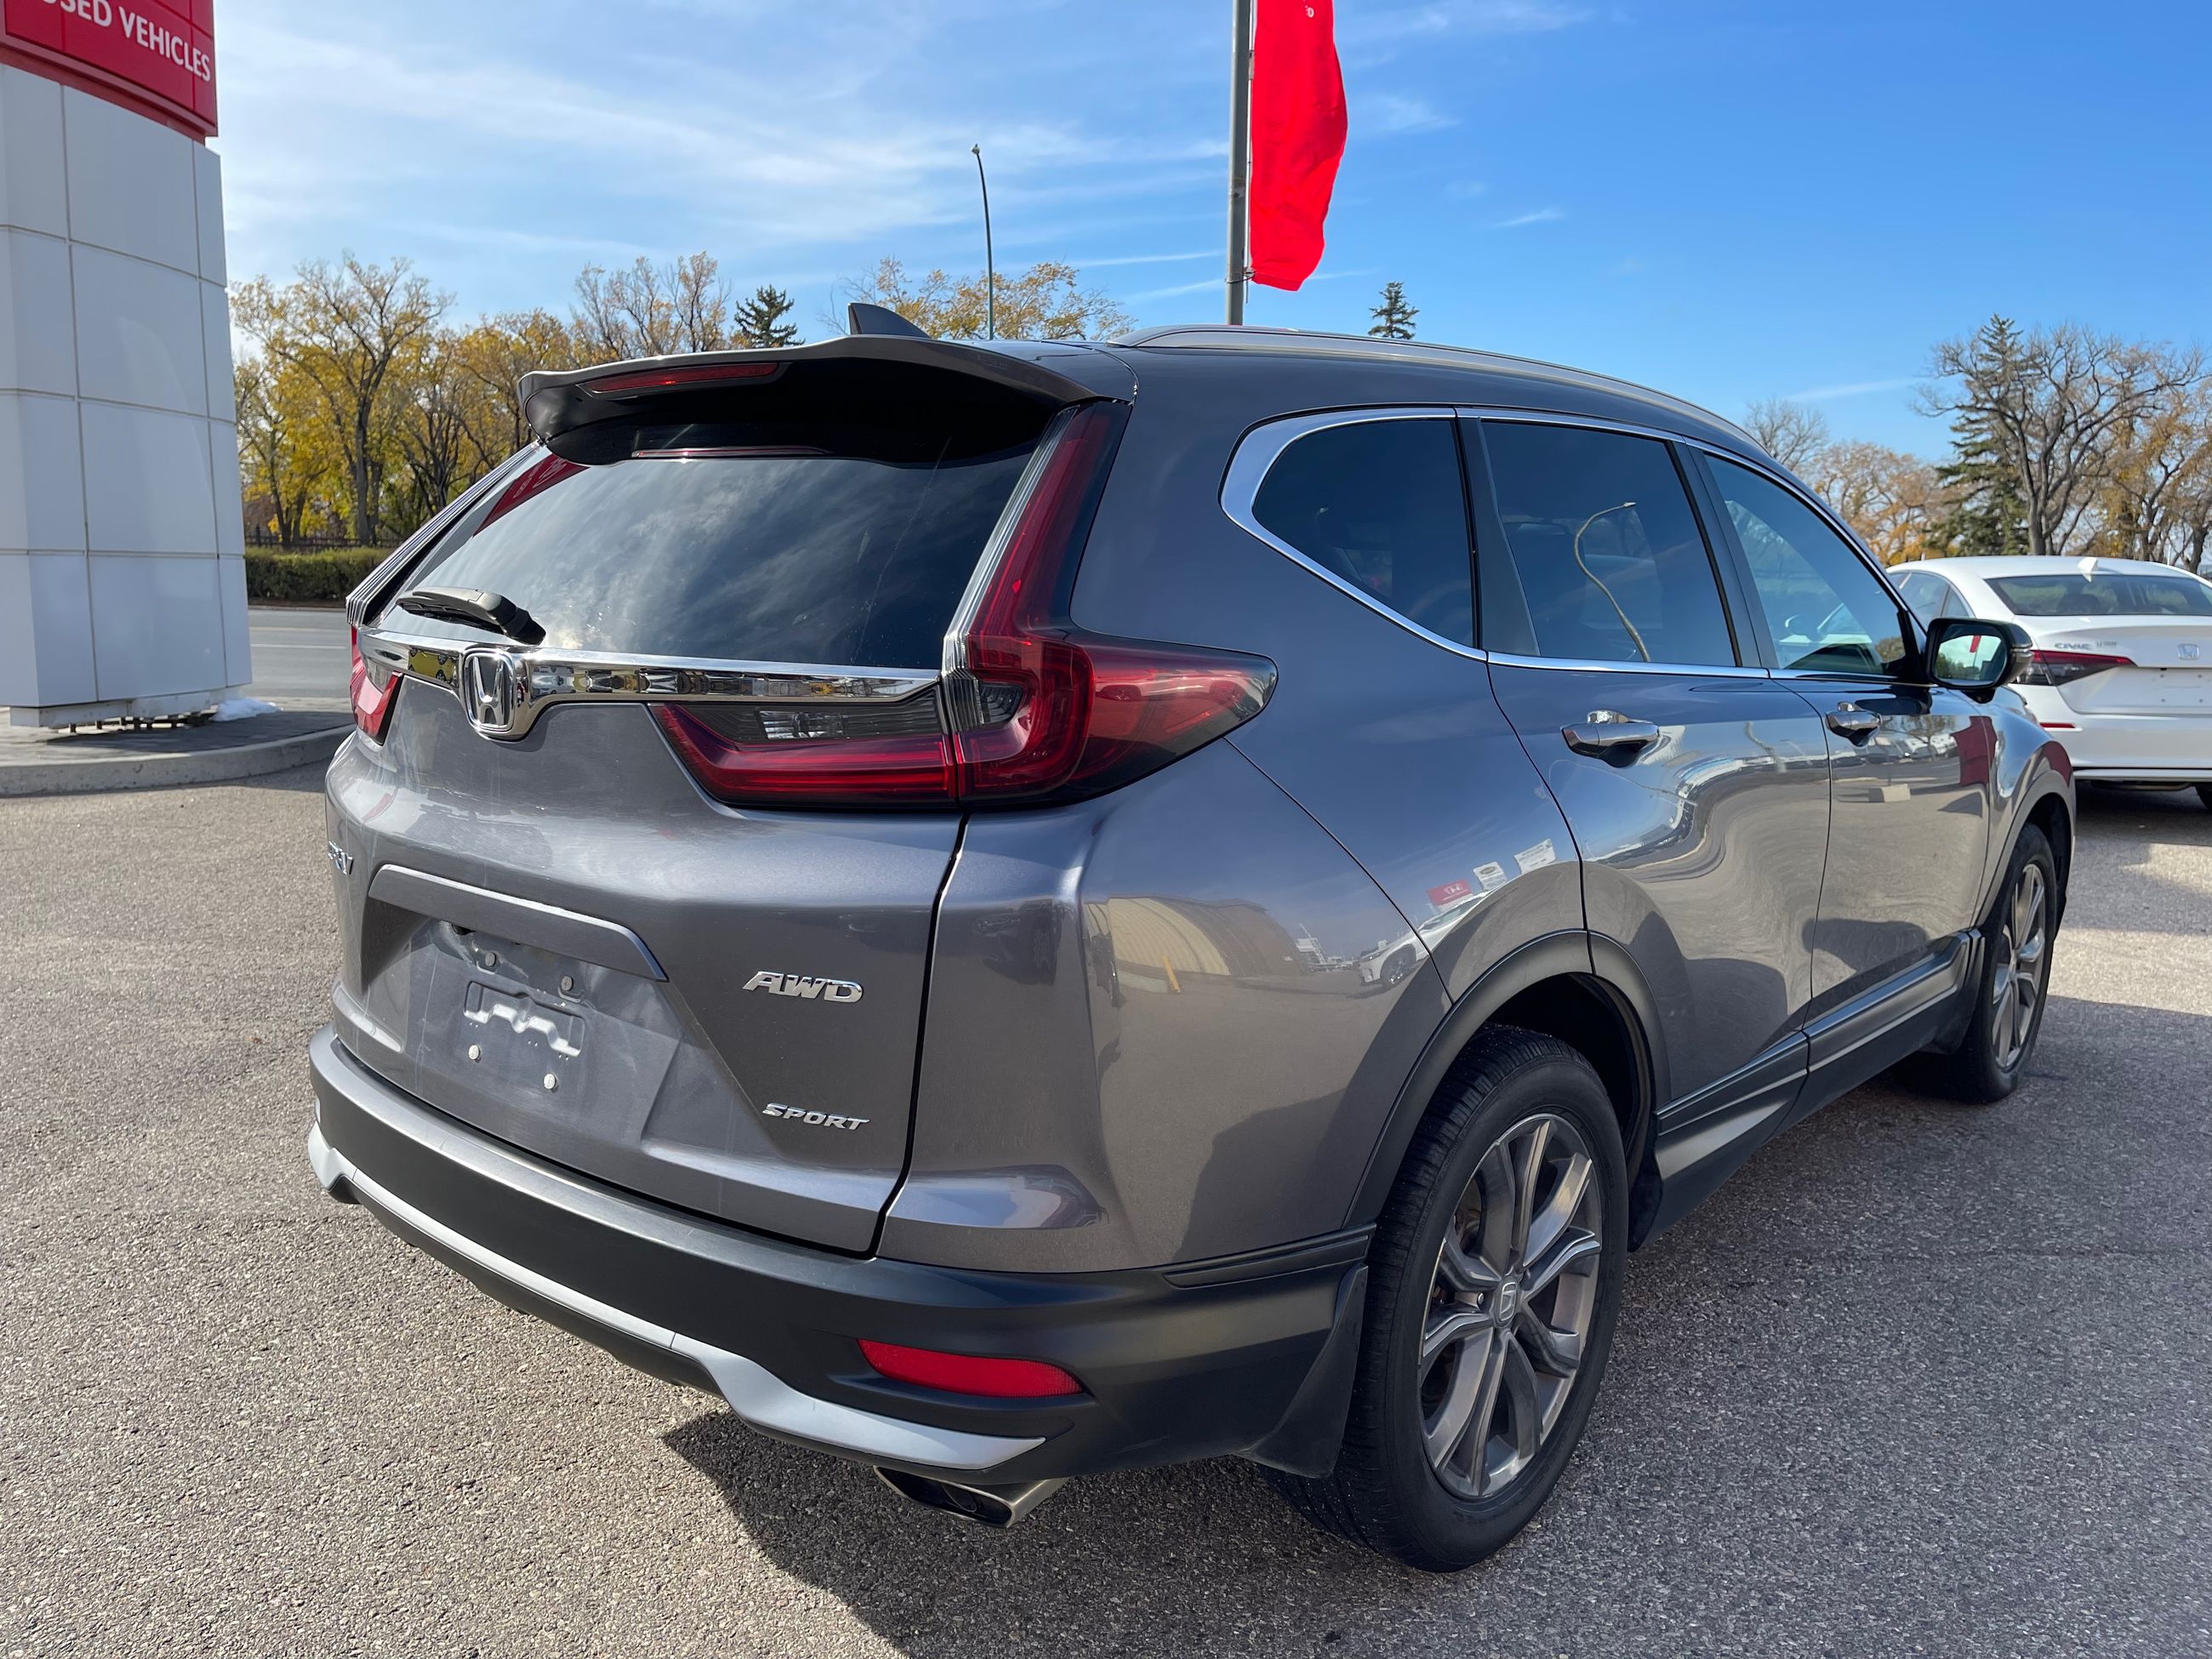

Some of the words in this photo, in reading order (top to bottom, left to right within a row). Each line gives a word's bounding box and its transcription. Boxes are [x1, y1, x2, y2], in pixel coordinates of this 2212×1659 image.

[118, 6, 211, 82] VEHICLES
[743, 971, 863, 1003] AWD
[762, 1103, 869, 1131] SPORT
